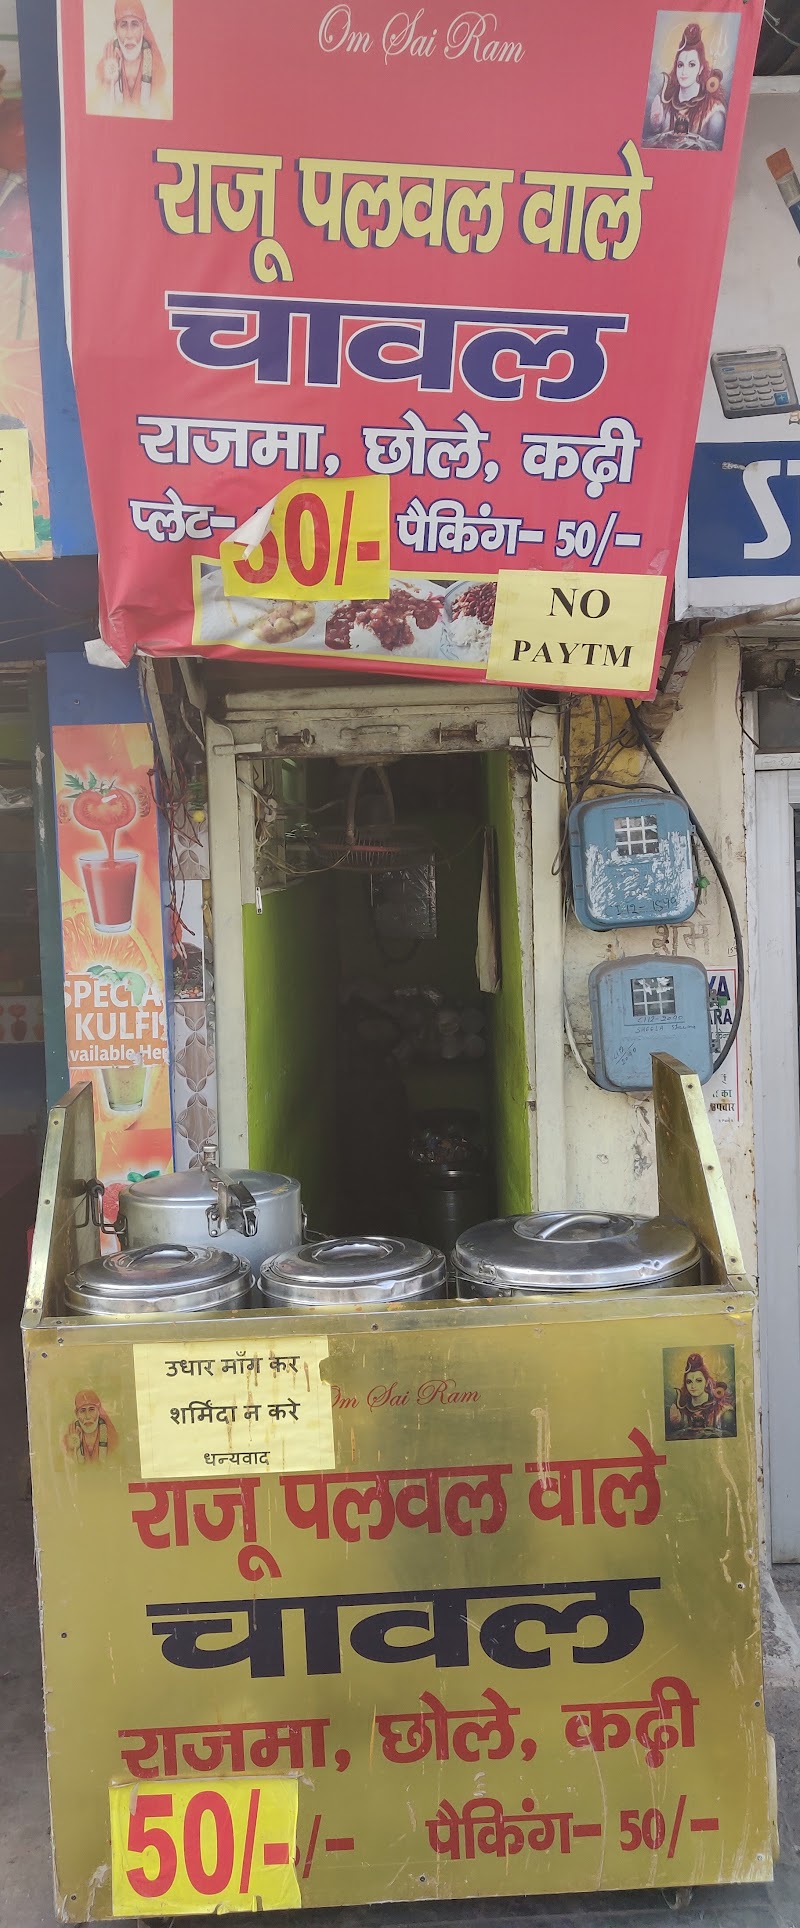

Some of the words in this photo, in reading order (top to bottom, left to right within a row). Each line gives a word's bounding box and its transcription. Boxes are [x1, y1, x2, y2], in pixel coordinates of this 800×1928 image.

[318, 3, 373, 53] Om
[382, 8, 437, 66] Sai
[444, 11, 526, 63] Ram
[153, 148, 293, 284] राजू
[298, 157, 515, 255] पलवल
[522, 139, 654, 261] वाले
[165, 291, 629, 402] चावल
[136, 415, 341, 477] राजमा,
[361, 409, 501, 483] छोले,
[521, 416, 643, 500] कढ़ी
[554, 512, 643, 568] 50/-
[743, 459, 800, 559] S
[546, 587, 611, 619] NO
[511, 639, 635, 668] PAYTM
[710, 1008, 733, 1025] RA
[68, 1044, 135, 1062] vailable
[164, 1359, 215, 1377] उधार
[220, 1350, 264, 1374] माँग
[269, 1355, 301, 1373] कर
[243, 1404, 262, 1422] न
[268, 1398, 301, 1421] करे
[367, 1381, 410, 1413] Sai
[416, 1379, 481, 1406] Ram
[203, 1451, 271, 1467] धन्यवाद
[129, 1477, 283, 1581] राजू
[278, 1464, 513, 1543] पलवल
[524, 1427, 667, 1529] वाले
[146, 1577, 661, 1679] चावल
[118, 1718, 351, 1779] राजमा,
[375, 1687, 537, 1764] छोले,
[561, 1676, 700, 1768] कढ़ी
[126, 1788, 289, 1898] 50/-
[425, 1798, 602, 1860] पैकिंग-
[620, 1795, 720, 1859] 50/-
